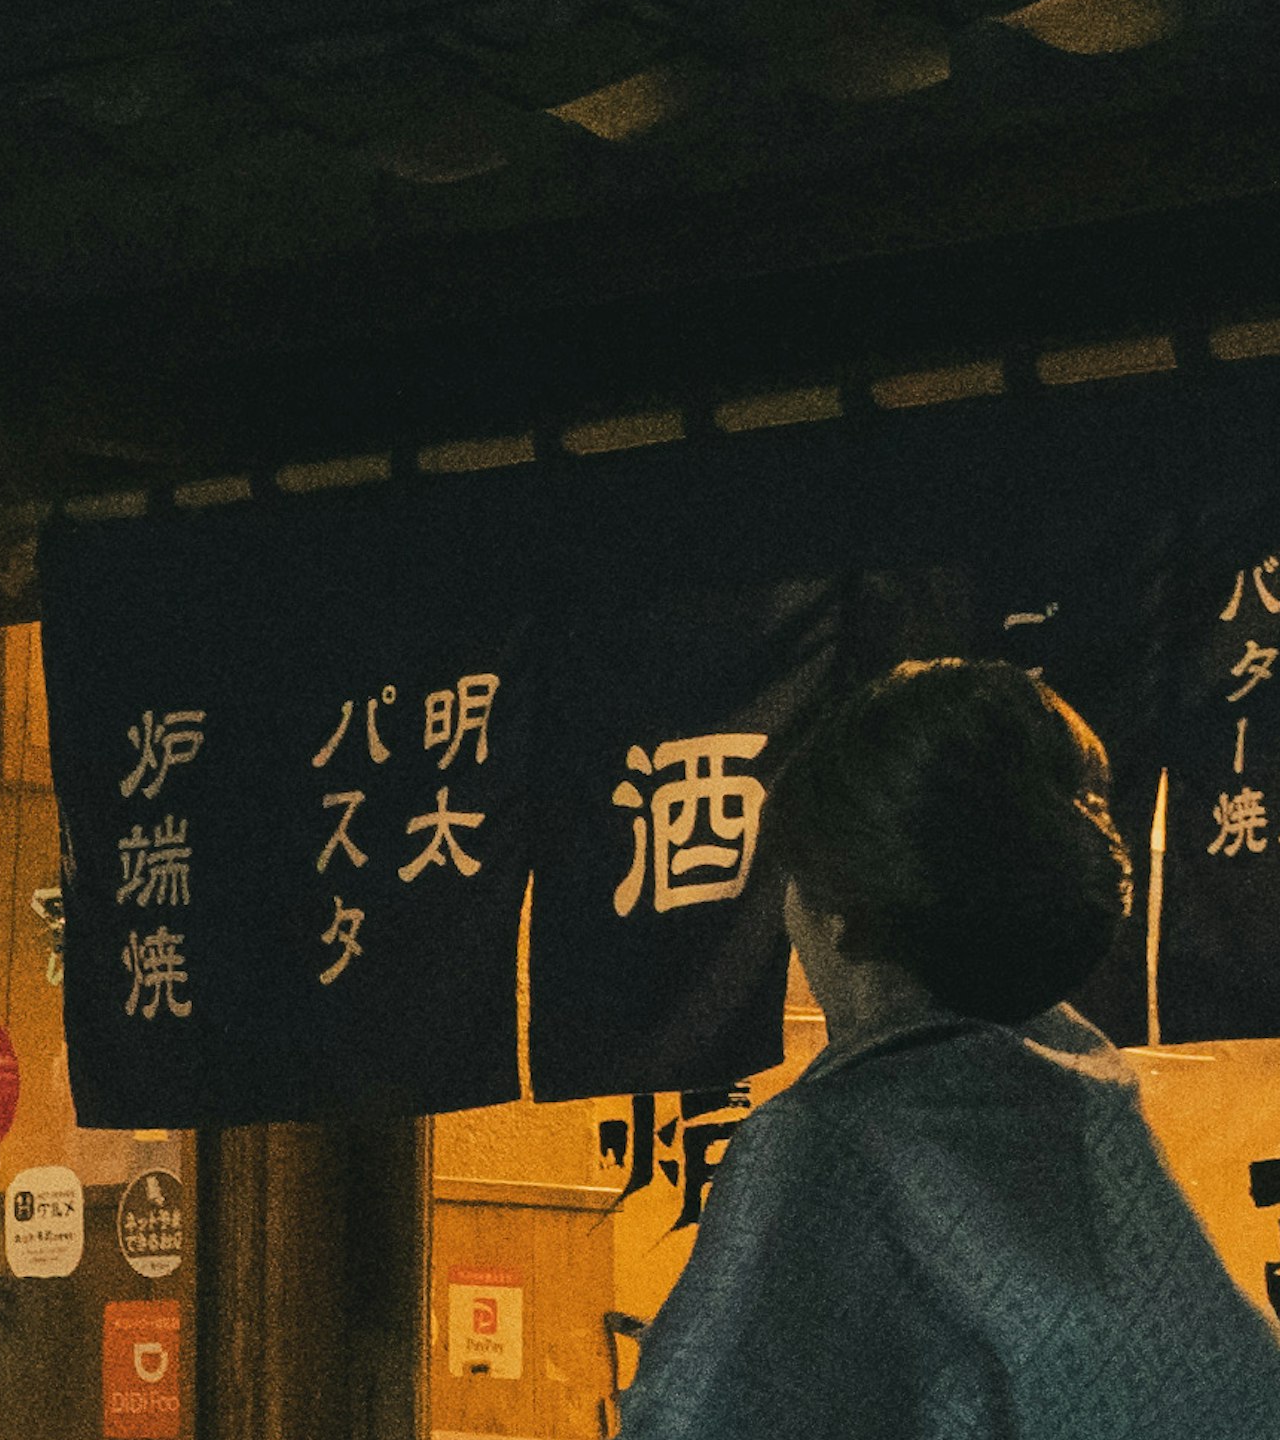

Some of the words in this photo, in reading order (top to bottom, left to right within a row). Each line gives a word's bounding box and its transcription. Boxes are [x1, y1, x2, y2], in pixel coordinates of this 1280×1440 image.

[116, 709, 207, 1020] 炉端焼
[311, 683, 398, 985] パスタ
[397, 671, 501, 882] 明太
[612, 732, 768, 917] 酒
